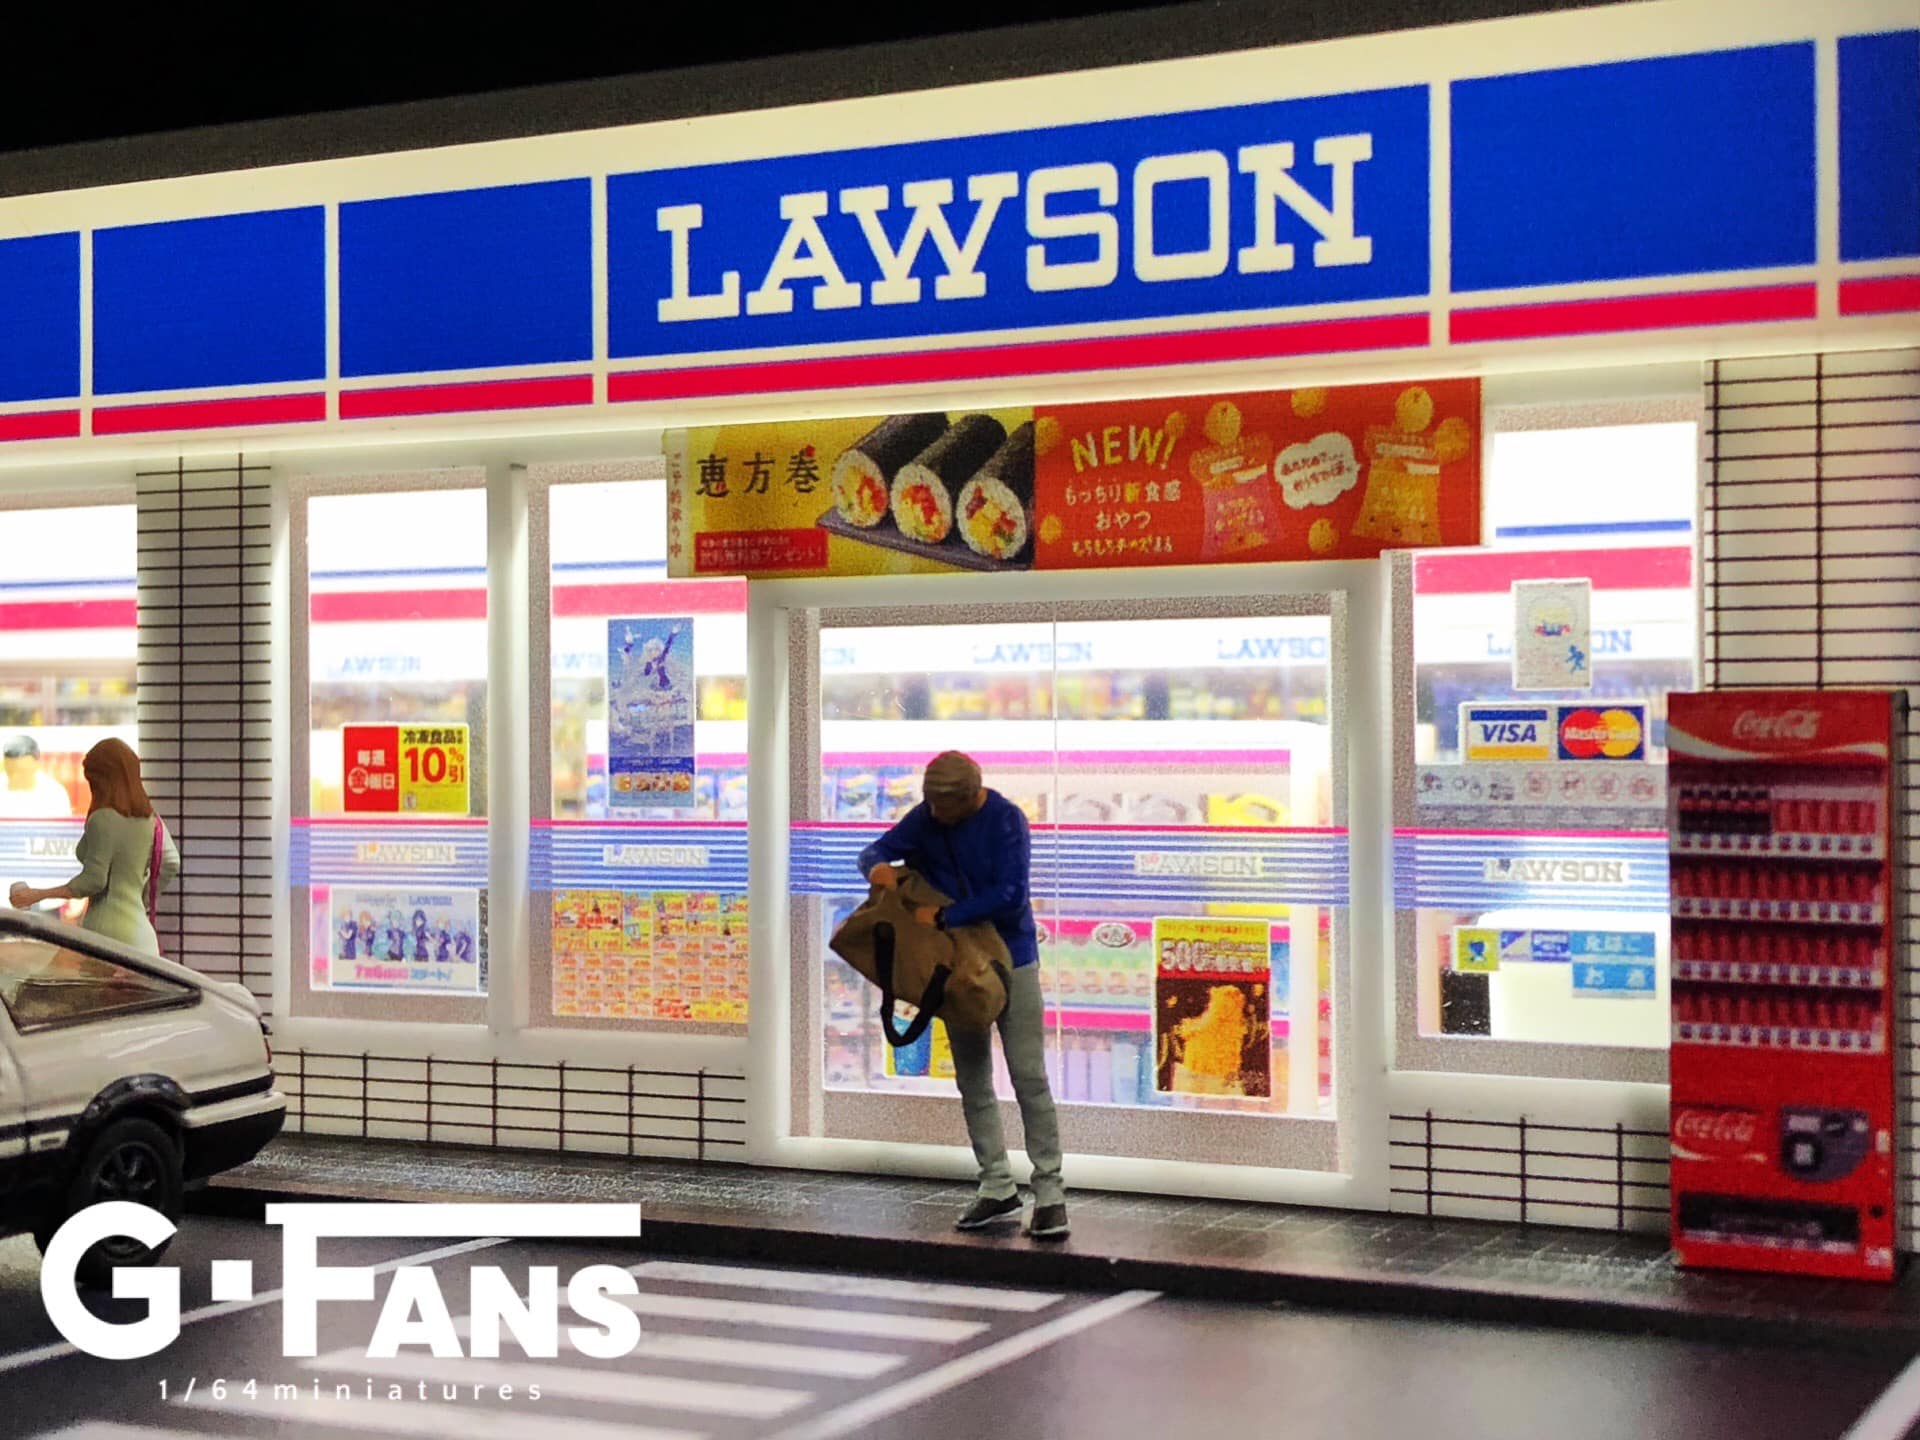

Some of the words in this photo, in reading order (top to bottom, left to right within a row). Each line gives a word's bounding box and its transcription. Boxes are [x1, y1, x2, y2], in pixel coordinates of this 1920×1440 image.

[657, 133, 1373, 323] LAWSON
[1070, 425, 1177, 473] NEW!
[695, 447, 822, 498] 恵方巻
[1095, 510, 1152, 531] おやつ
[1217, 636, 1326, 660] LAWSO
[1481, 723, 1537, 743] VISA
[358, 844, 454, 863] LAWSON
[605, 846, 706, 866] LAWSON
[1140, 853, 1258, 875] LAWSON
[1486, 860, 1625, 883] LAWSON
